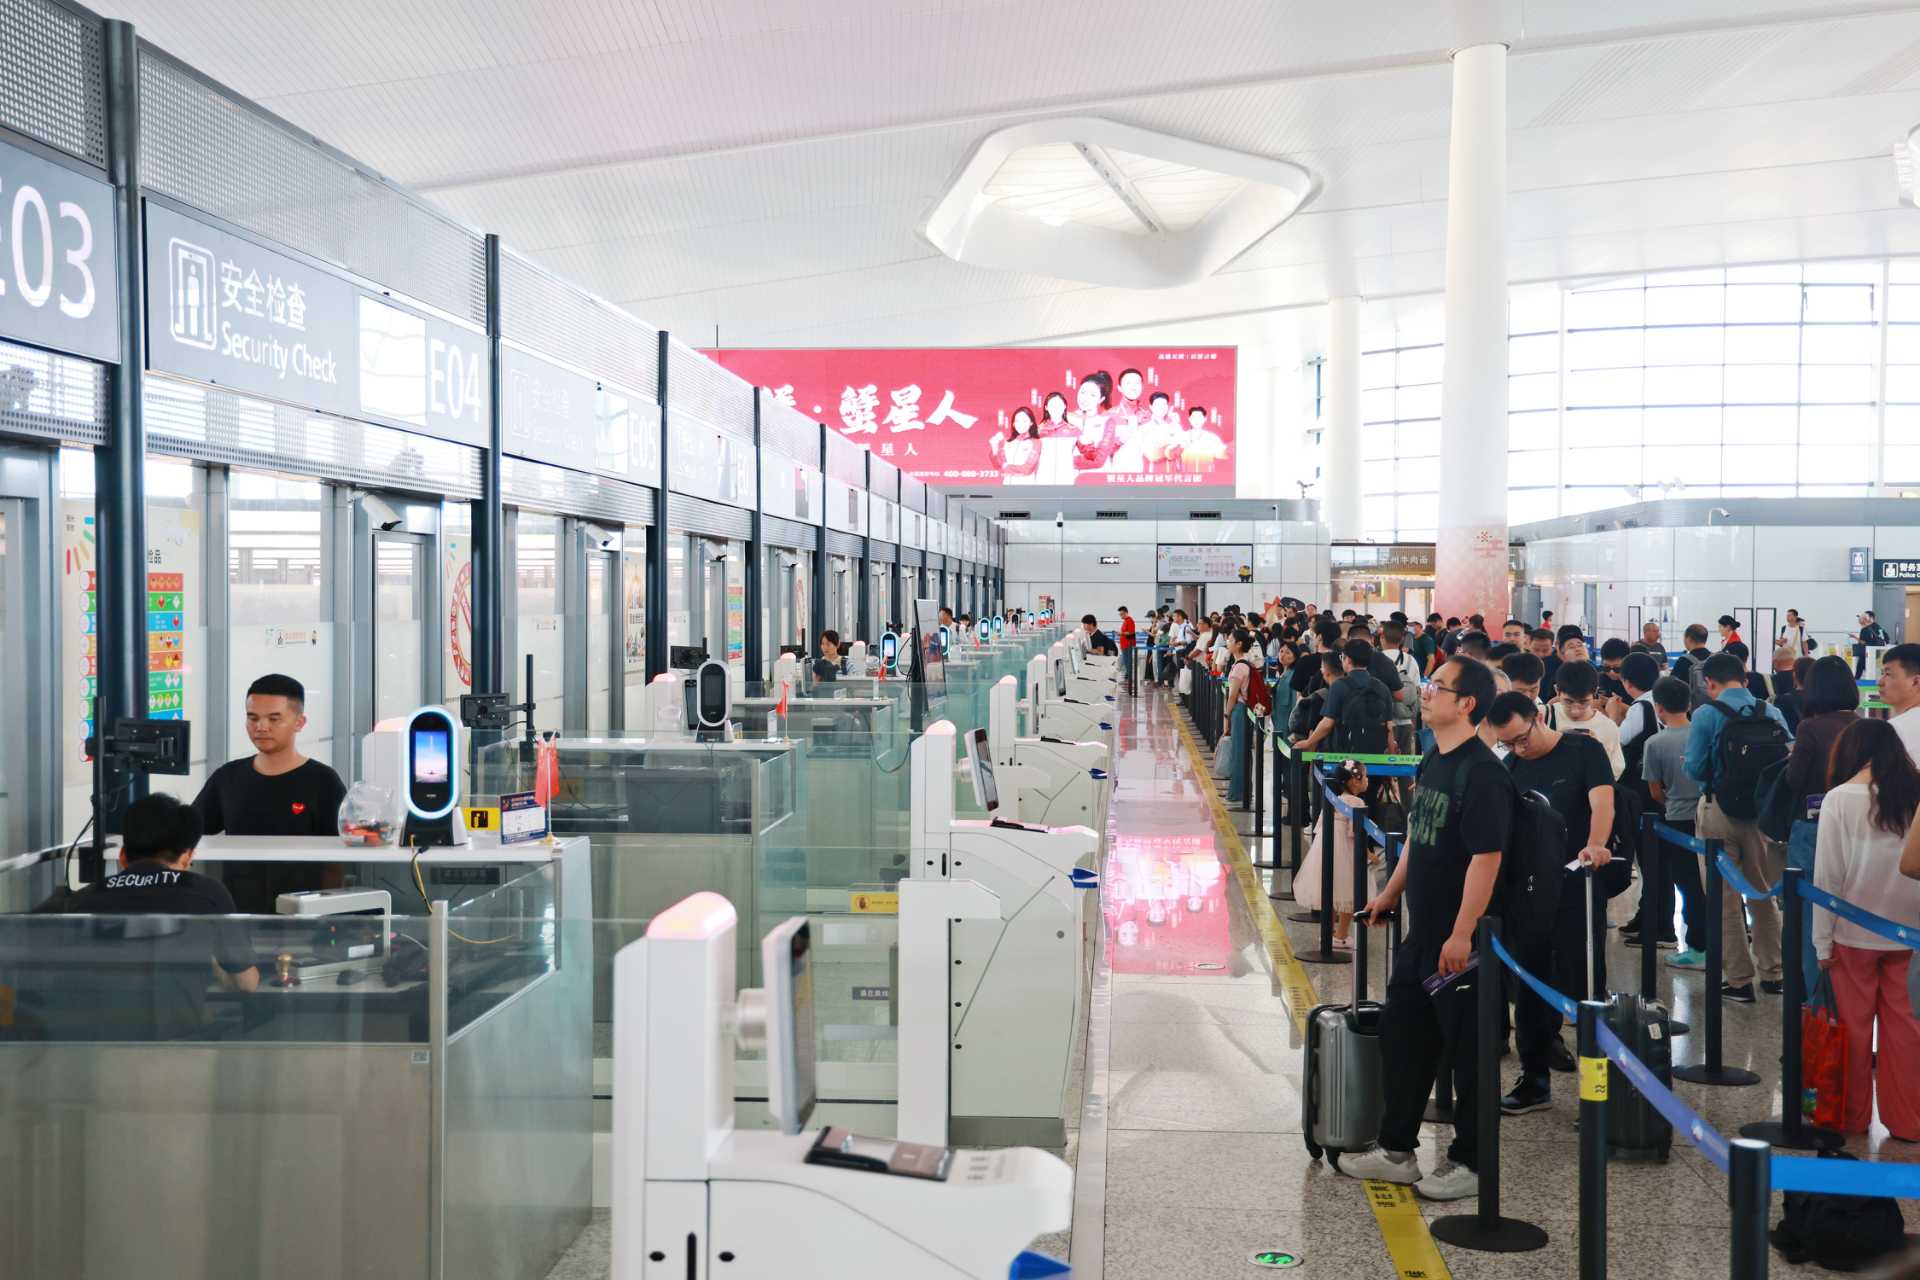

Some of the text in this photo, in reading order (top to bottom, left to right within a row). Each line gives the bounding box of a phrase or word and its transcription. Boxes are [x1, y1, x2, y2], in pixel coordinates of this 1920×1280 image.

[0, 176, 95, 319] 03
[221, 259, 307, 331] 安全检查
[222, 321, 337, 384] Security Check
[430, 337, 481, 423] E04
[106, 871, 181, 889] SECURITY
